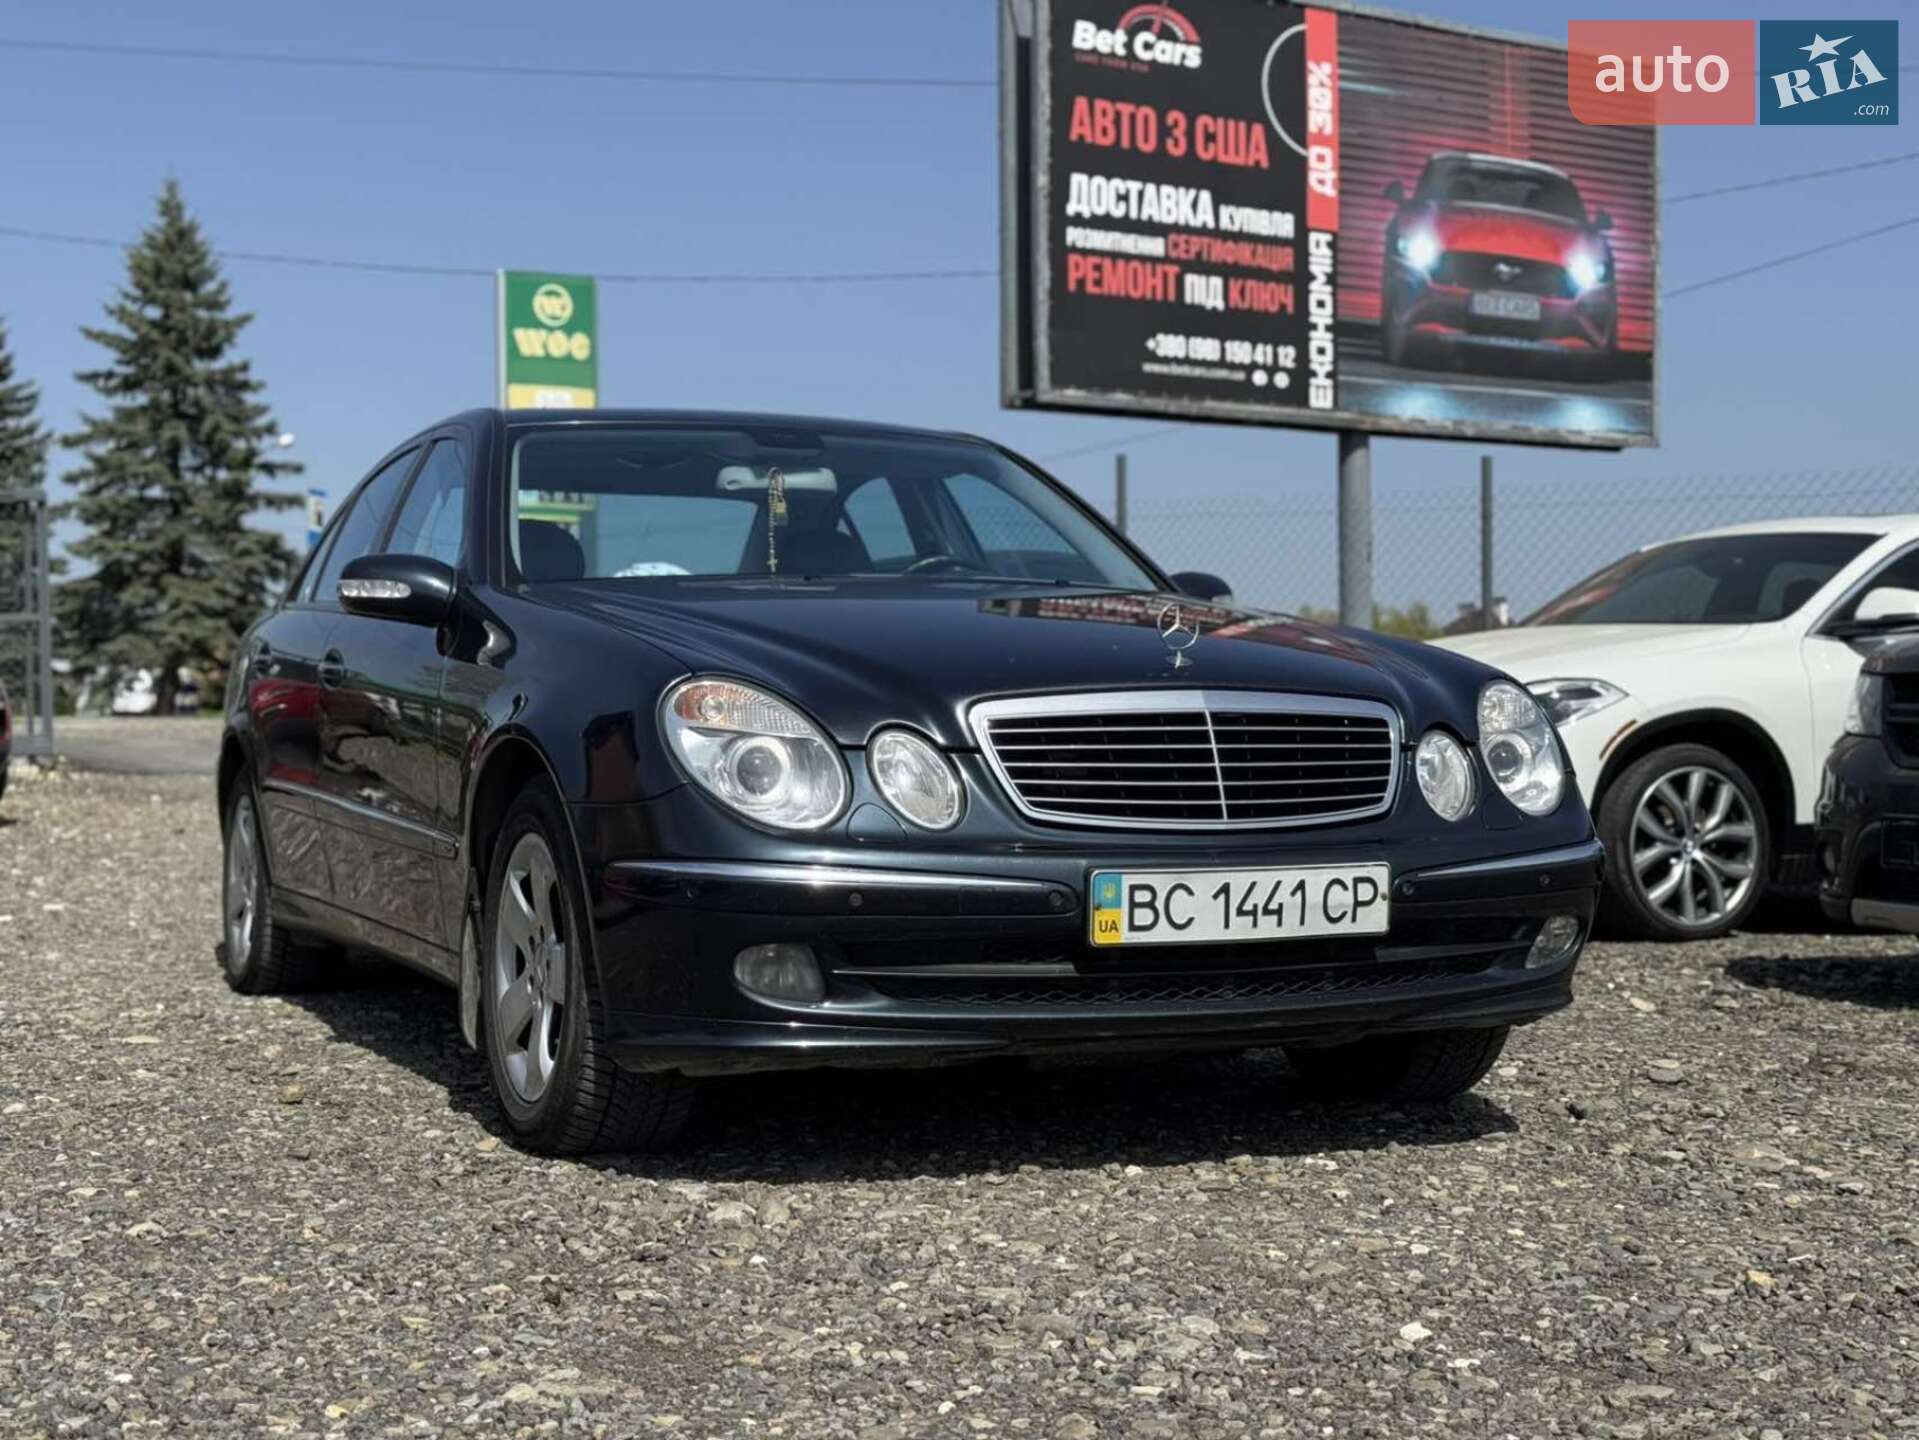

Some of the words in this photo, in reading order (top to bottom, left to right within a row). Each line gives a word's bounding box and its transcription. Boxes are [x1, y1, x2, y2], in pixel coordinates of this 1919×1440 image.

[1072, 19, 1128, 57] Bet
[1133, 31, 1203, 69] Cars
[1307, 61, 1333, 136] 30%
[1069, 96, 1158, 154] АВТО
[1195, 114, 1270, 170] США
[1307, 145, 1338, 198] ДО
[1066, 172, 1216, 230] ДОСТАВКА
[1067, 253, 1181, 302] РЕМОНТ
[1184, 273, 1226, 312] ПІД
[1228, 277, 1295, 316] КЛЮЧ
[1308, 231, 1335, 410] ЕКОНОМІЯ
[1253, 342, 1273, 367] 41
[1276, 345, 1297, 369] 12
[1098, 919, 1119, 933] UA
[1127, 882, 1196, 932] BC
[1211, 878, 1307, 930] 1441
[1321, 875, 1379, 925] CP
